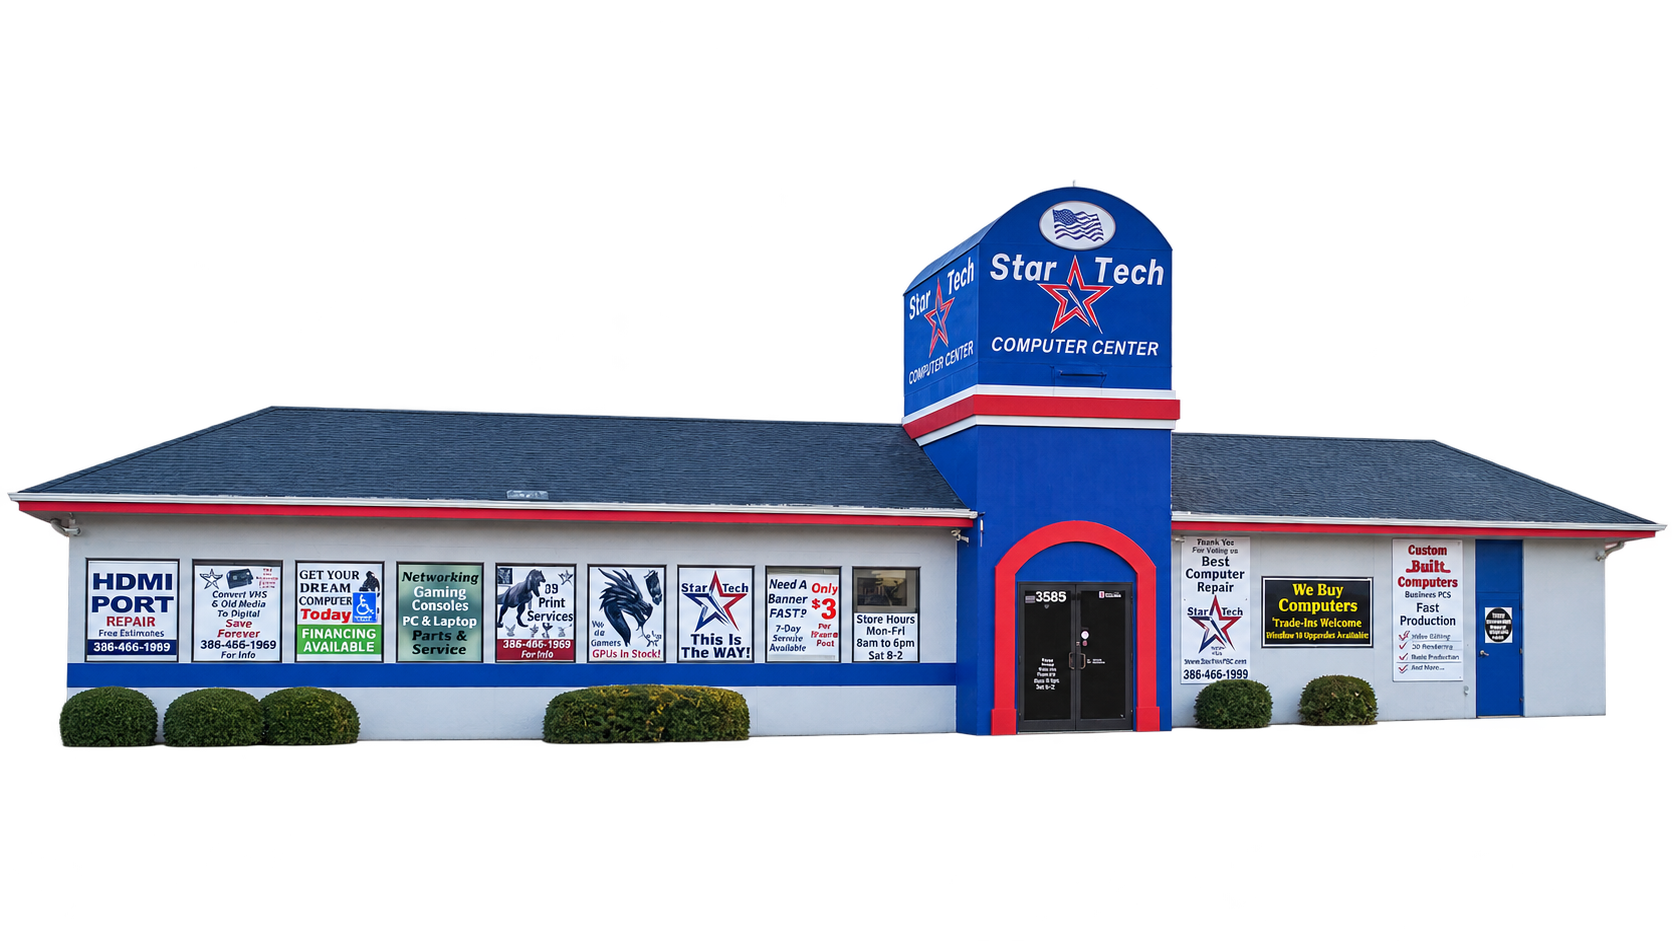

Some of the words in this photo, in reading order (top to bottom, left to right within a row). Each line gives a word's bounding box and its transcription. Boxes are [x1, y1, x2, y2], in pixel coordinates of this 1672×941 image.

[990, 253, 1057, 281] Star
[1095, 256, 1164, 285] Tech
[909, 290, 931, 320] Star
[947, 257, 974, 295] Tech
[991, 336, 1087, 354] COMPUTER
[1092, 340, 1159, 356] CENTER
[909, 356, 944, 384] COMPUTER
[945, 340, 973, 367] CENTER
[1408, 545, 1447, 555] Custom
[1202, 556, 1230, 567] Best
[1406, 559, 1451, 573] Built
[299, 570, 324, 580] GET
[327, 570, 360, 580] YOUR
[402, 572, 479, 585] Networking
[1186, 568, 1245, 581] Computer
[93, 573, 172, 590] HDMI
[769, 579, 797, 589] Need
[799, 580, 807, 589] A
[1398, 576, 1458, 589] Computers
[300, 583, 351, 593] DREAM
[414, 586, 466, 600] Gaming
[681, 583, 707, 592] Star
[722, 583, 749, 592] Tech
[812, 583, 838, 595] Only
[1197, 582, 1234, 594] Repair
[1292, 584, 1313, 596] We
[1317, 584, 1344, 598] Buy
[212, 590, 246, 598] Convert
[768, 594, 808, 604] Banner
[1035, 591, 1067, 602] 3585
[92, 596, 174, 613] PORT
[221, 600, 237, 608] Old
[238, 600, 266, 608] Media
[299, 596, 352, 606] COMPUTER
[412, 599, 469, 611] Consoles
[539, 597, 565, 608] Print
[1279, 598, 1358, 615] Computers
[769, 608, 807, 618] FAST?
[812, 598, 837, 619] $3
[1187, 607, 1209, 615] Star
[1222, 607, 1243, 615] Tech
[1417, 603, 1439, 612] Fast
[231, 610, 260, 619] Digital
[300, 608, 352, 623] Today
[527, 611, 573, 621] Services
[857, 615, 883, 624] Store
[886, 615, 915, 624] Hours
[106, 616, 155, 627] REPAIR
[226, 619, 252, 628] Save
[403, 616, 419, 626] PC
[421, 616, 431, 626] &
[434, 616, 477, 629] Laptop
[1320, 618, 1362, 628] Welcome
[1400, 615, 1455, 626] Production
[217, 629, 260, 638] Forever
[302, 628, 376, 639] FINANCING
[776, 624, 801, 634] 7-Day
[866, 626, 905, 635] Mon-Fri
[412, 630, 452, 641] Parts
[456, 630, 467, 641] &
[691, 633, 723, 646] This
[729, 634, 742, 646] Is
[303, 641, 375, 652] AVAILABLE
[412, 644, 466, 654] Service
[856, 639, 878, 647] 8am
[881, 639, 891, 647] to
[893, 639, 914, 649] 6pm
[221, 651, 236, 659] For
[238, 651, 255, 659] Info
[521, 650, 536, 658] For
[592, 649, 617, 658] GPUs
[621, 649, 629, 658] In
[632, 649, 661, 658] Stock!
[681, 647, 709, 658] The
[713, 647, 750, 658] WAY!
[868, 651, 884, 660] Sat
[887, 651, 903, 660] 8-2
